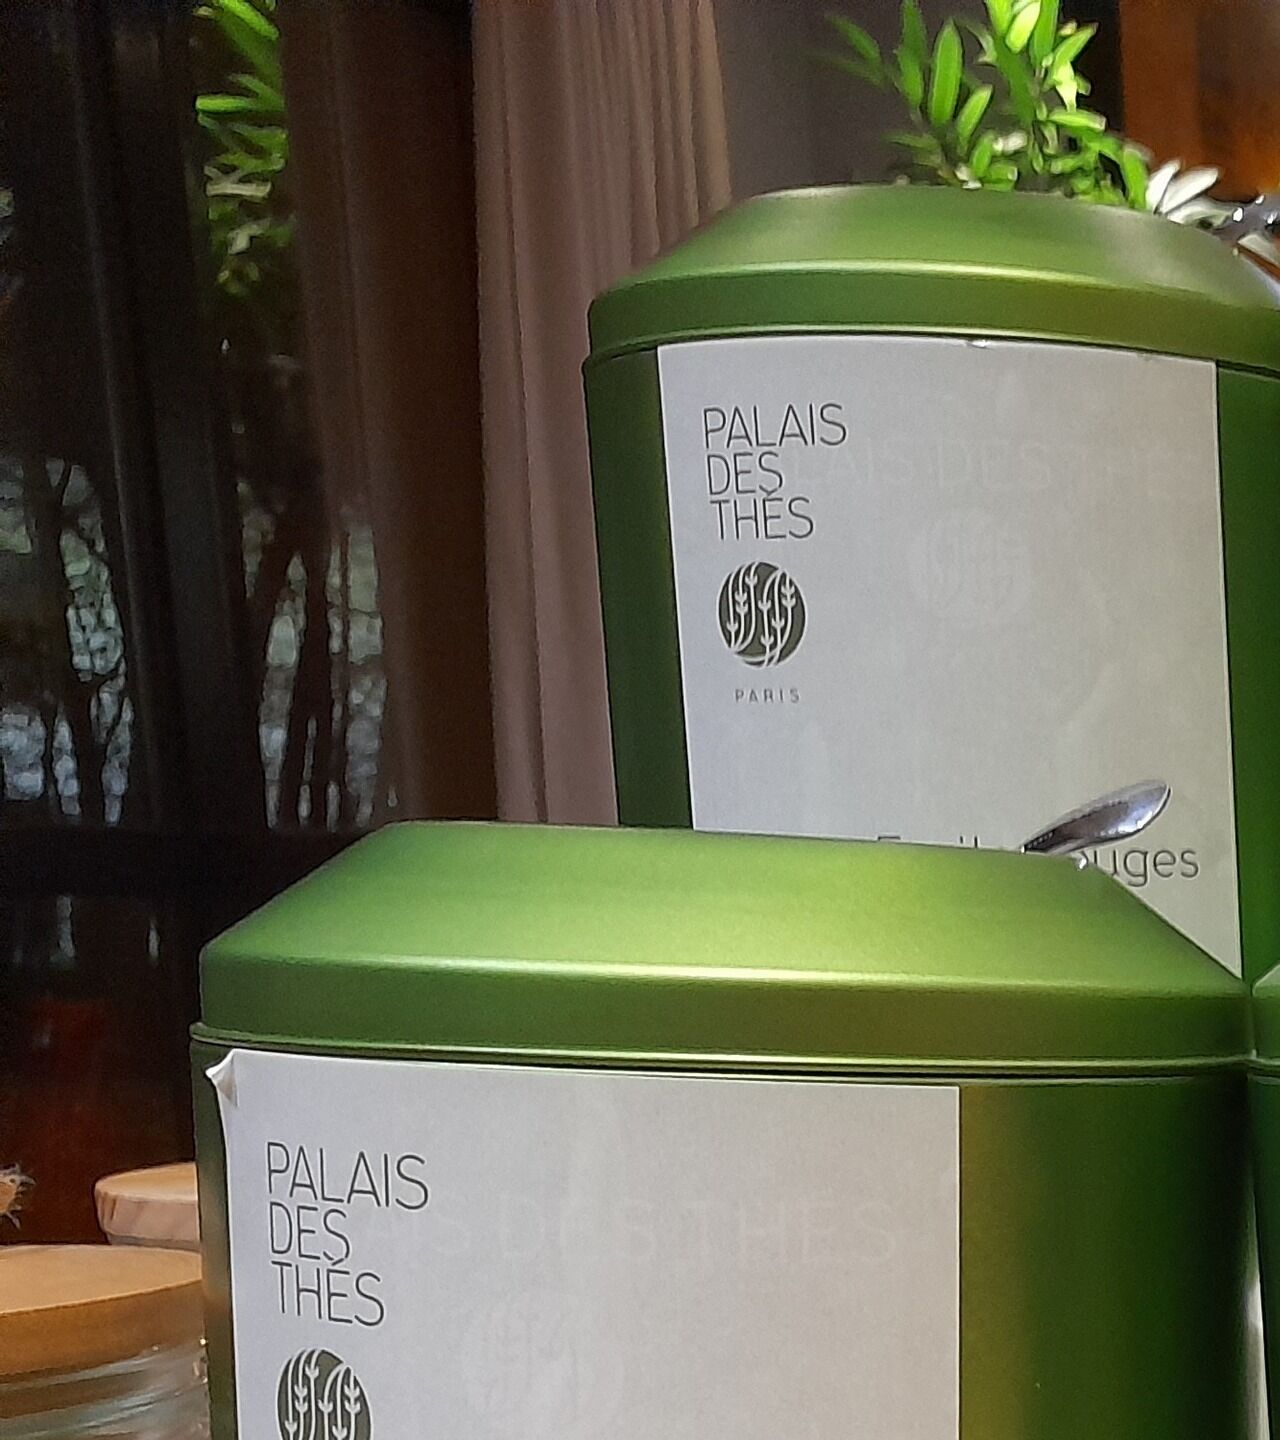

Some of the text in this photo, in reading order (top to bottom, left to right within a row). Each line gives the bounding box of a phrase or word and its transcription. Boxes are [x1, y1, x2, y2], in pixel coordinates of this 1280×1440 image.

[703, 402, 848, 449] PALAIS
[706, 451, 783, 495] DES
[710, 489, 815, 541] THÉS
[734, 687, 801, 704] PARIS
[266, 1141, 430, 1210] PALAIS
[268, 1201, 351, 1263] DES
[270, 1256, 385, 1327] THÉS
